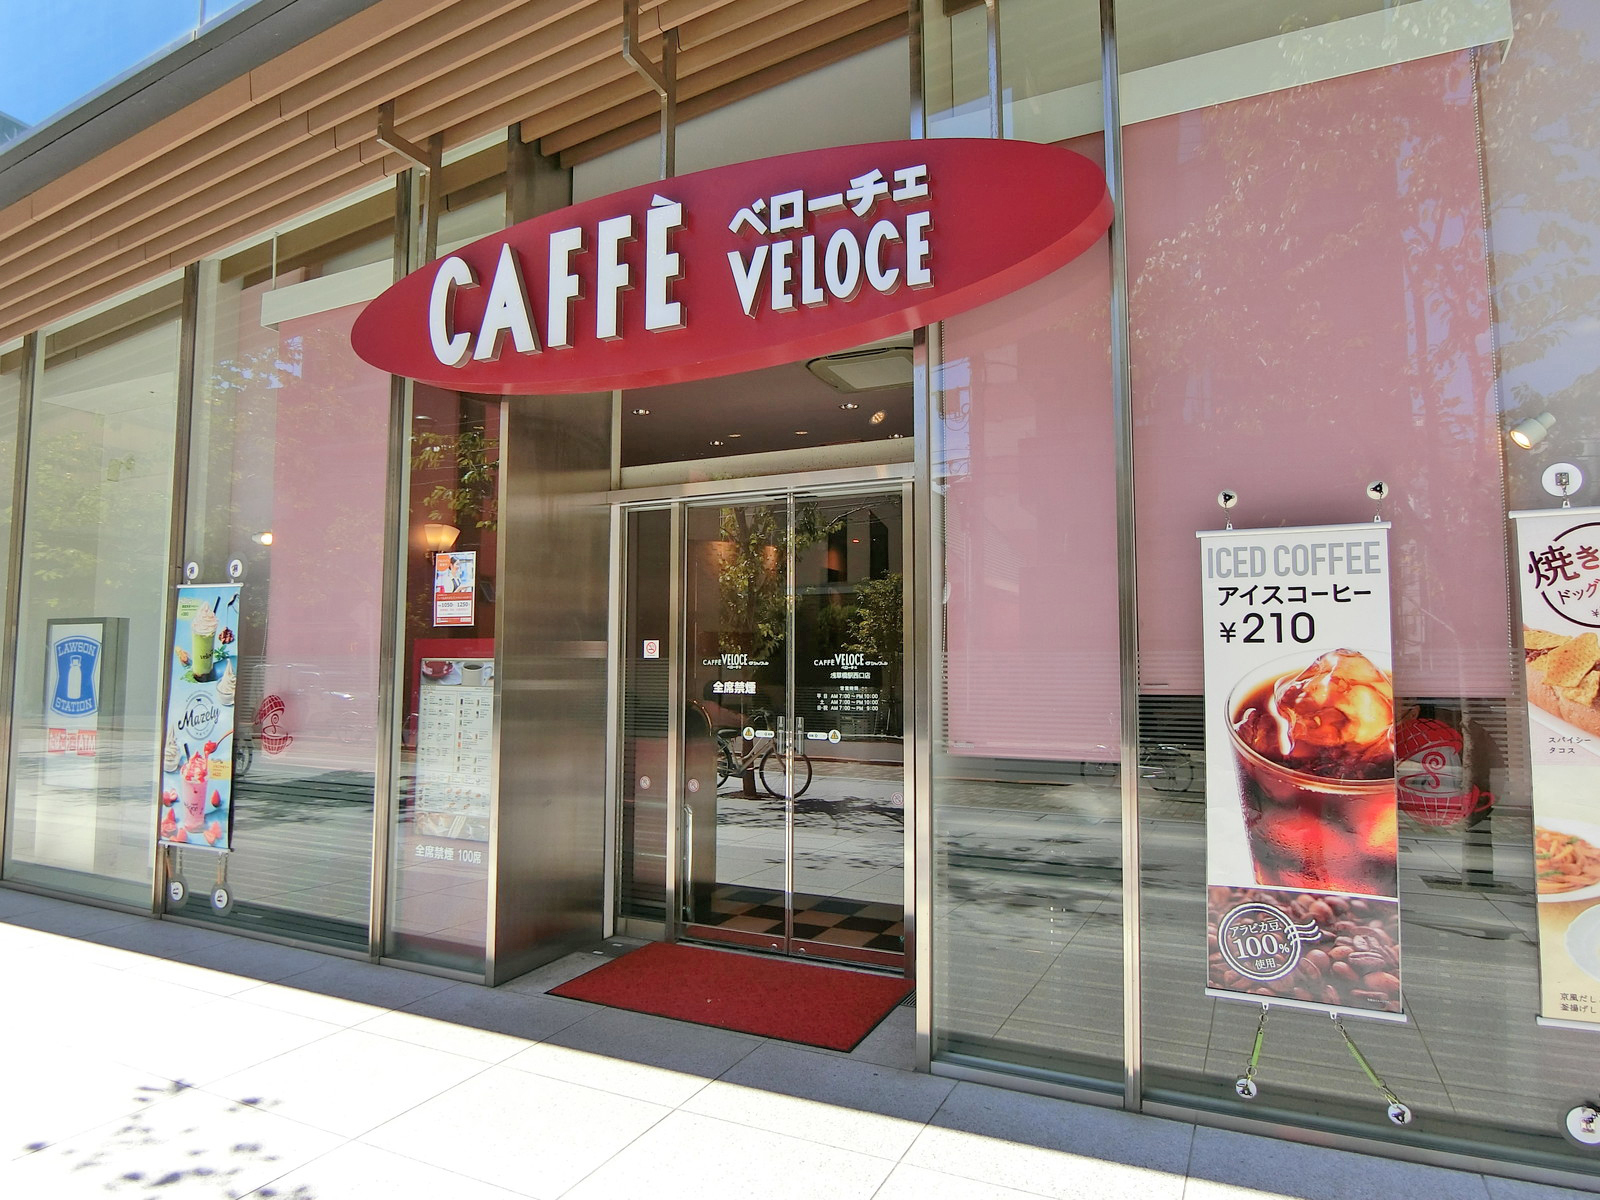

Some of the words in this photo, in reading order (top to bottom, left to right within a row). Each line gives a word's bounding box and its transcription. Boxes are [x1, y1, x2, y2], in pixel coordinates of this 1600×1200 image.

[728, 164, 932, 237] ベローチェ
[428, 194, 688, 368] CAFFÈ
[727, 211, 934, 319] VELOCE
[1207, 545, 1267, 578] ICED
[1273, 541, 1381, 577] COFFEE
[1528, 545, 1600, 589] 焼き
[1218, 584, 1372, 606] アイスコーヒー
[1557, 578, 1600, 605] ドッグ
[1219, 612, 1315, 643] ¥210
[58, 641, 96, 657] LAWSON
[721, 653, 748, 666] VELOCE
[834, 653, 864, 666] VELOCE
[712, 681, 756, 694] 全席禁煙
[55, 697, 92, 712] STATION
[178, 706, 220, 731] Mazely
[1548, 736, 1591, 744] スパイシー
[415, 844, 454, 861] 全席禁煙
[458, 849, 482, 864] 100席
[1229, 918, 1282, 938] アラビカ豆
[1232, 934, 1290, 959] 100%
[1255, 958, 1276, 970] 使用
[1560, 992, 1600, 1004] 京風だし
